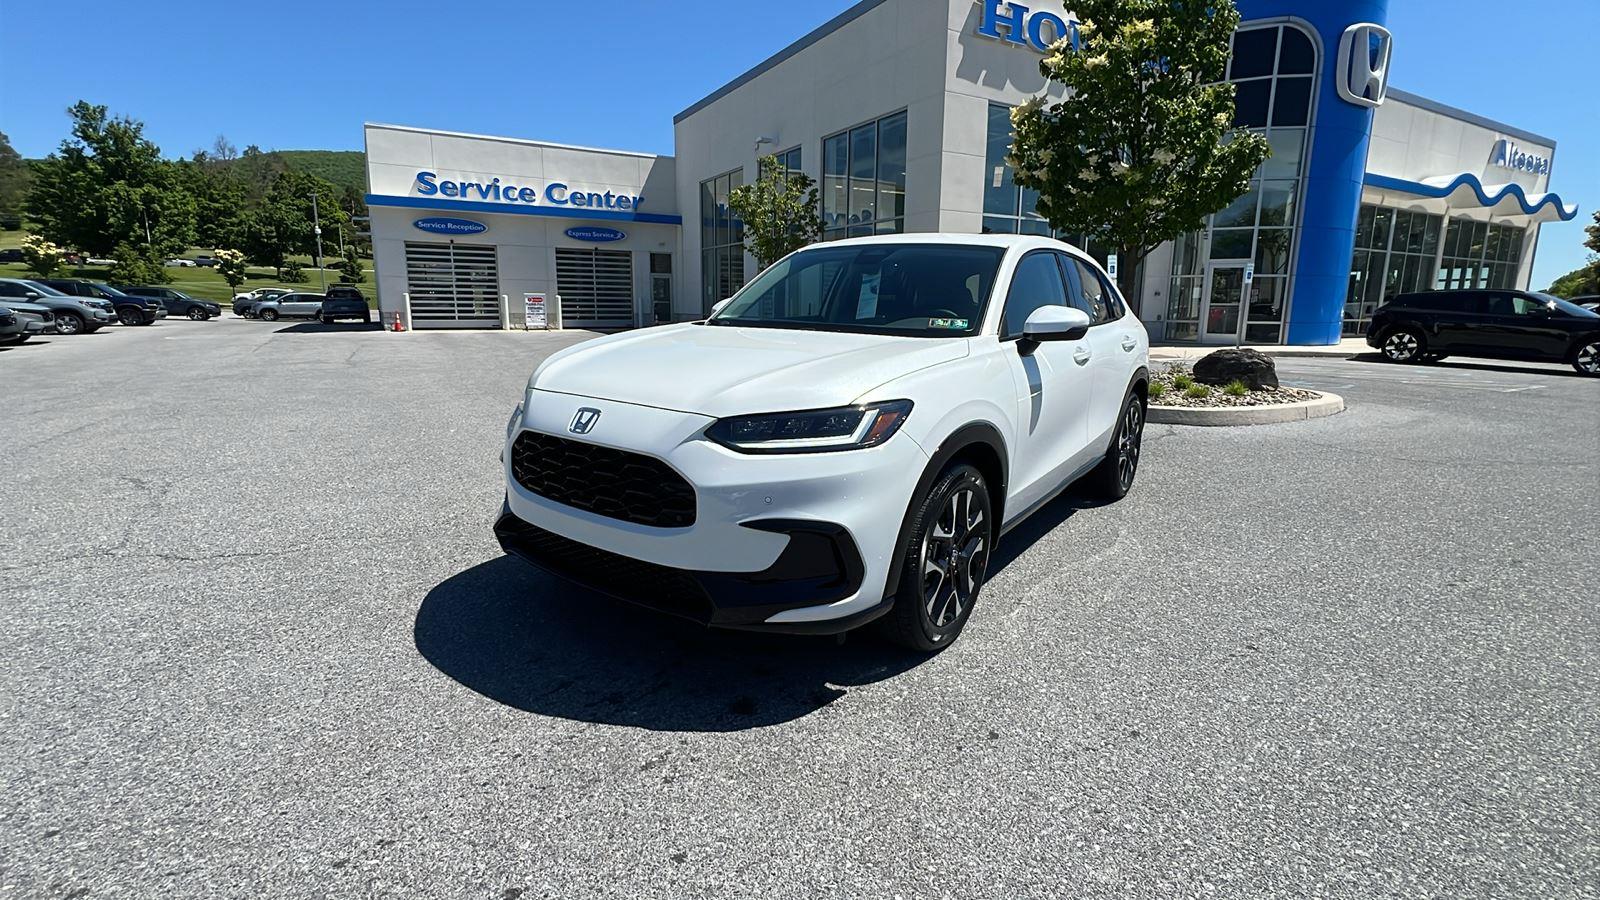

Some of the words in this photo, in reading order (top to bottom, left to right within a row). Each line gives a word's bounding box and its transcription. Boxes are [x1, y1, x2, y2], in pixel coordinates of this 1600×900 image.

[1496, 139, 1548, 176] Altoona
[416, 171, 536, 203] Service
[545, 182, 645, 210] Center
[417, 221, 446, 229] Service
[447, 222, 484, 232] Reception
